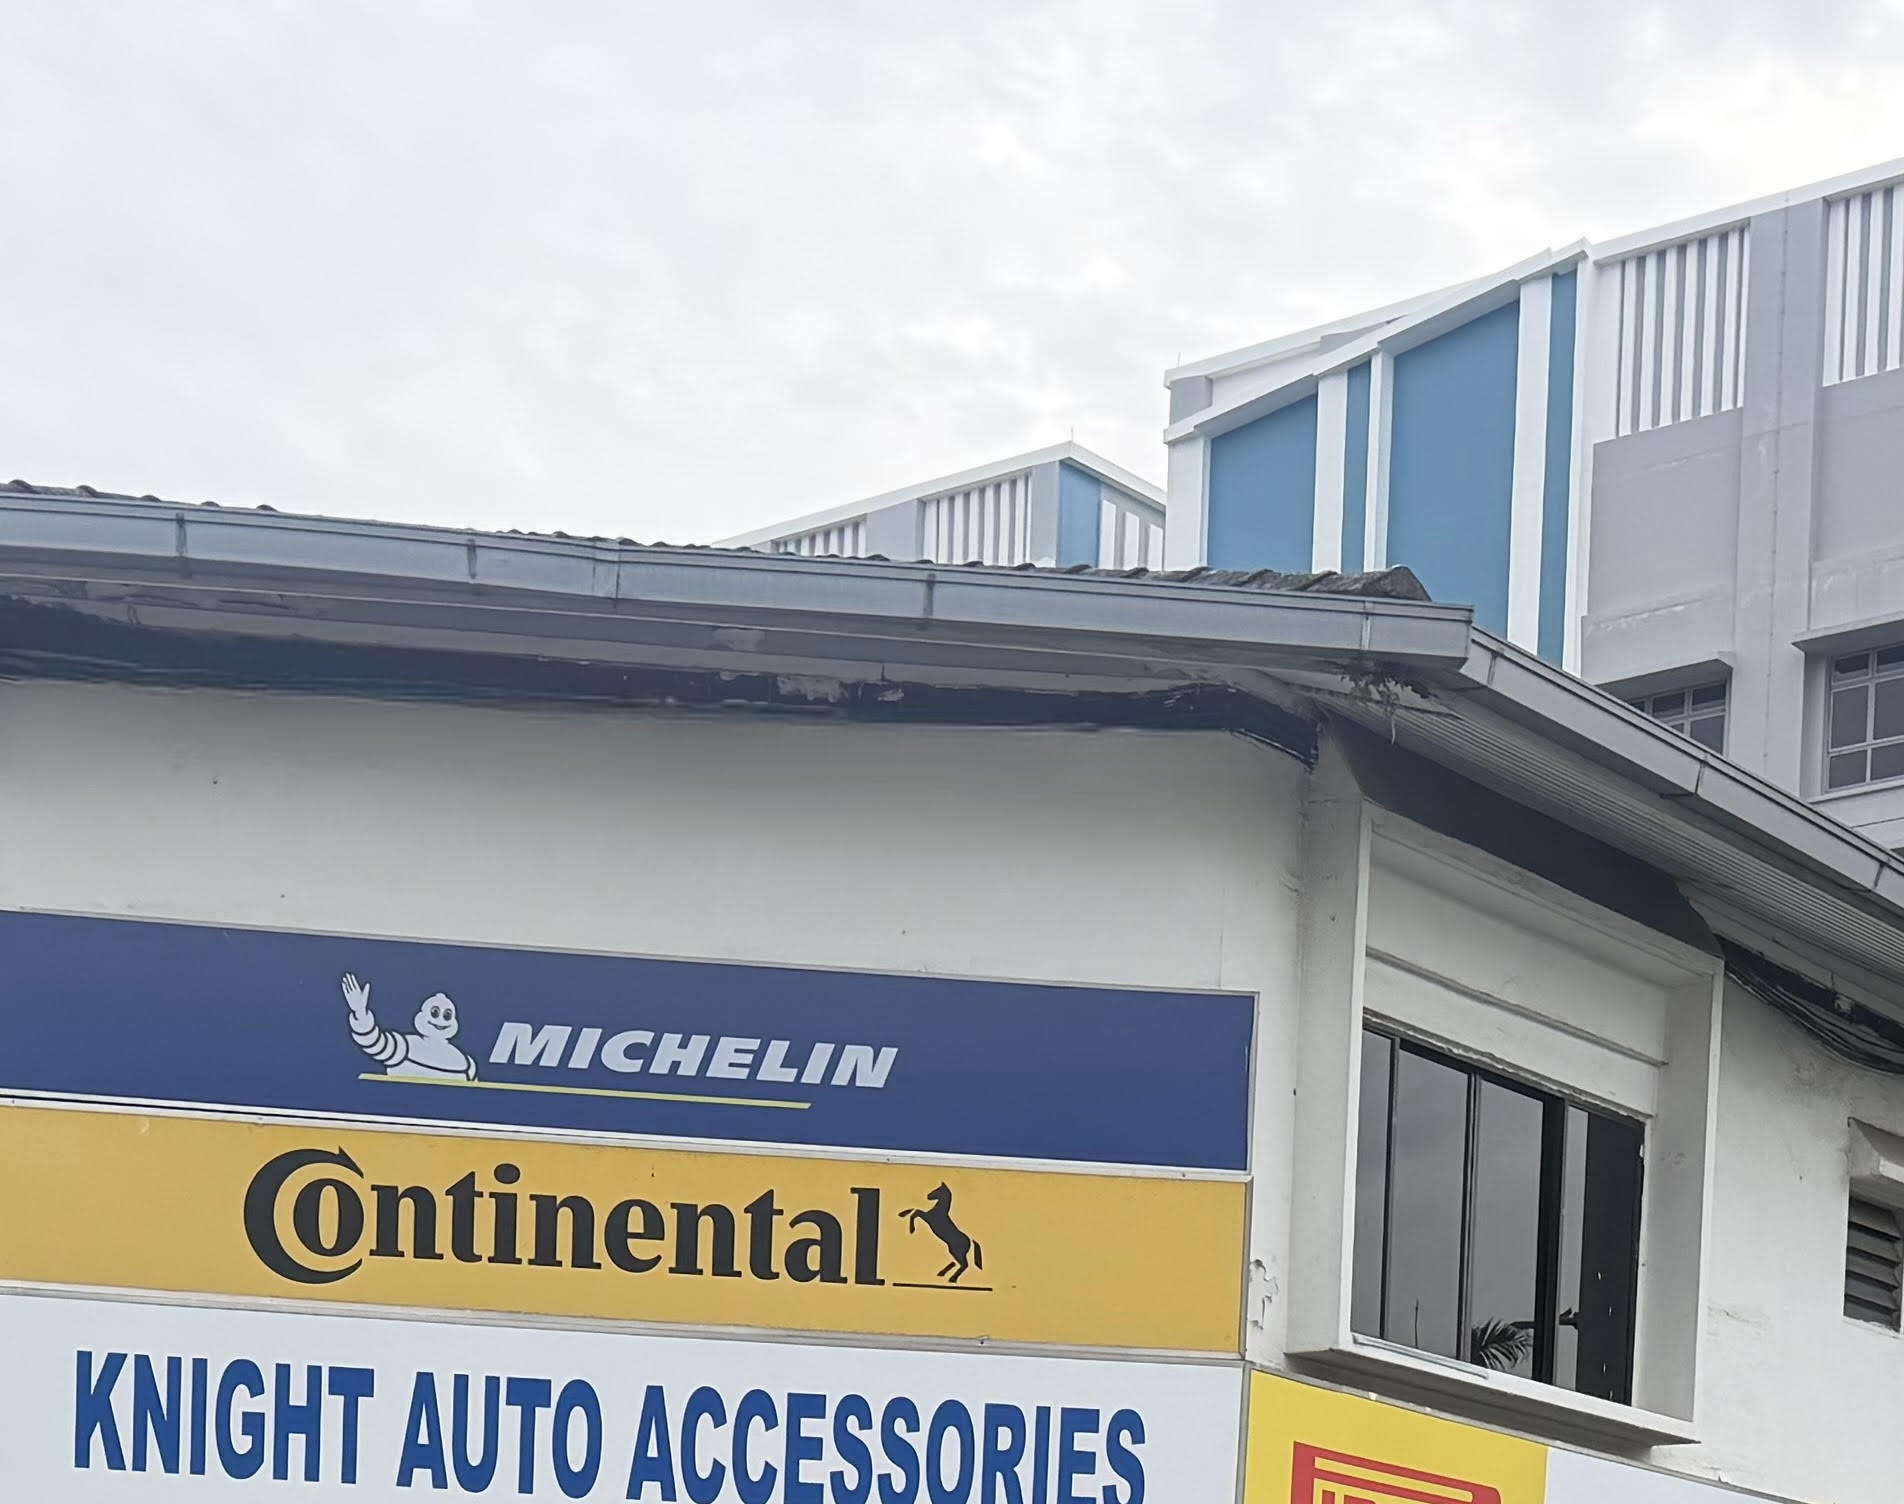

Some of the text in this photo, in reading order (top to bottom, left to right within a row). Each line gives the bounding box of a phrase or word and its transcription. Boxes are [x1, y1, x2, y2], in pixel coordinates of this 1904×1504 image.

[488, 1020, 899, 1090] MICHELIN
[243, 1146, 887, 1286] Continental
[72, 1350, 376, 1485] KNIGHT
[397, 1371, 602, 1500] AUTO
